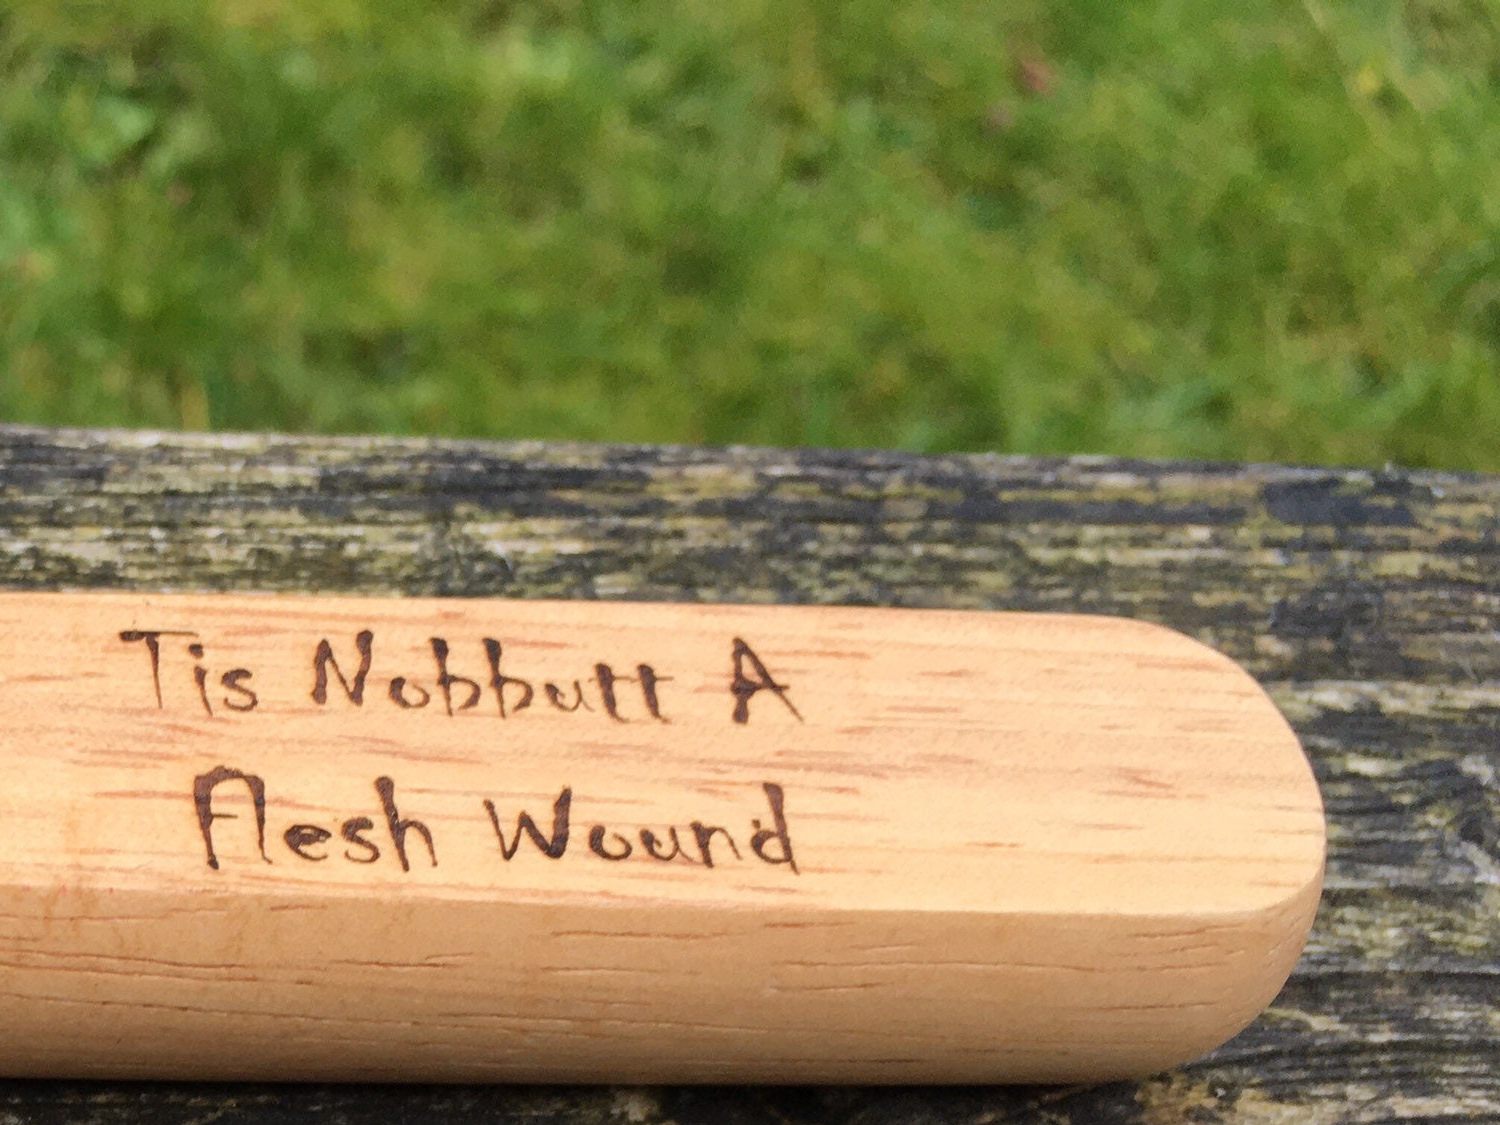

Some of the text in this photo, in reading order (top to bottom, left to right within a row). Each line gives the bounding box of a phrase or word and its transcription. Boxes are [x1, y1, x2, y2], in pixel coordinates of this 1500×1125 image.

[119, 629, 805, 723] Tis Nobbutt A
[193, 765, 799, 876] Flesh Wound
